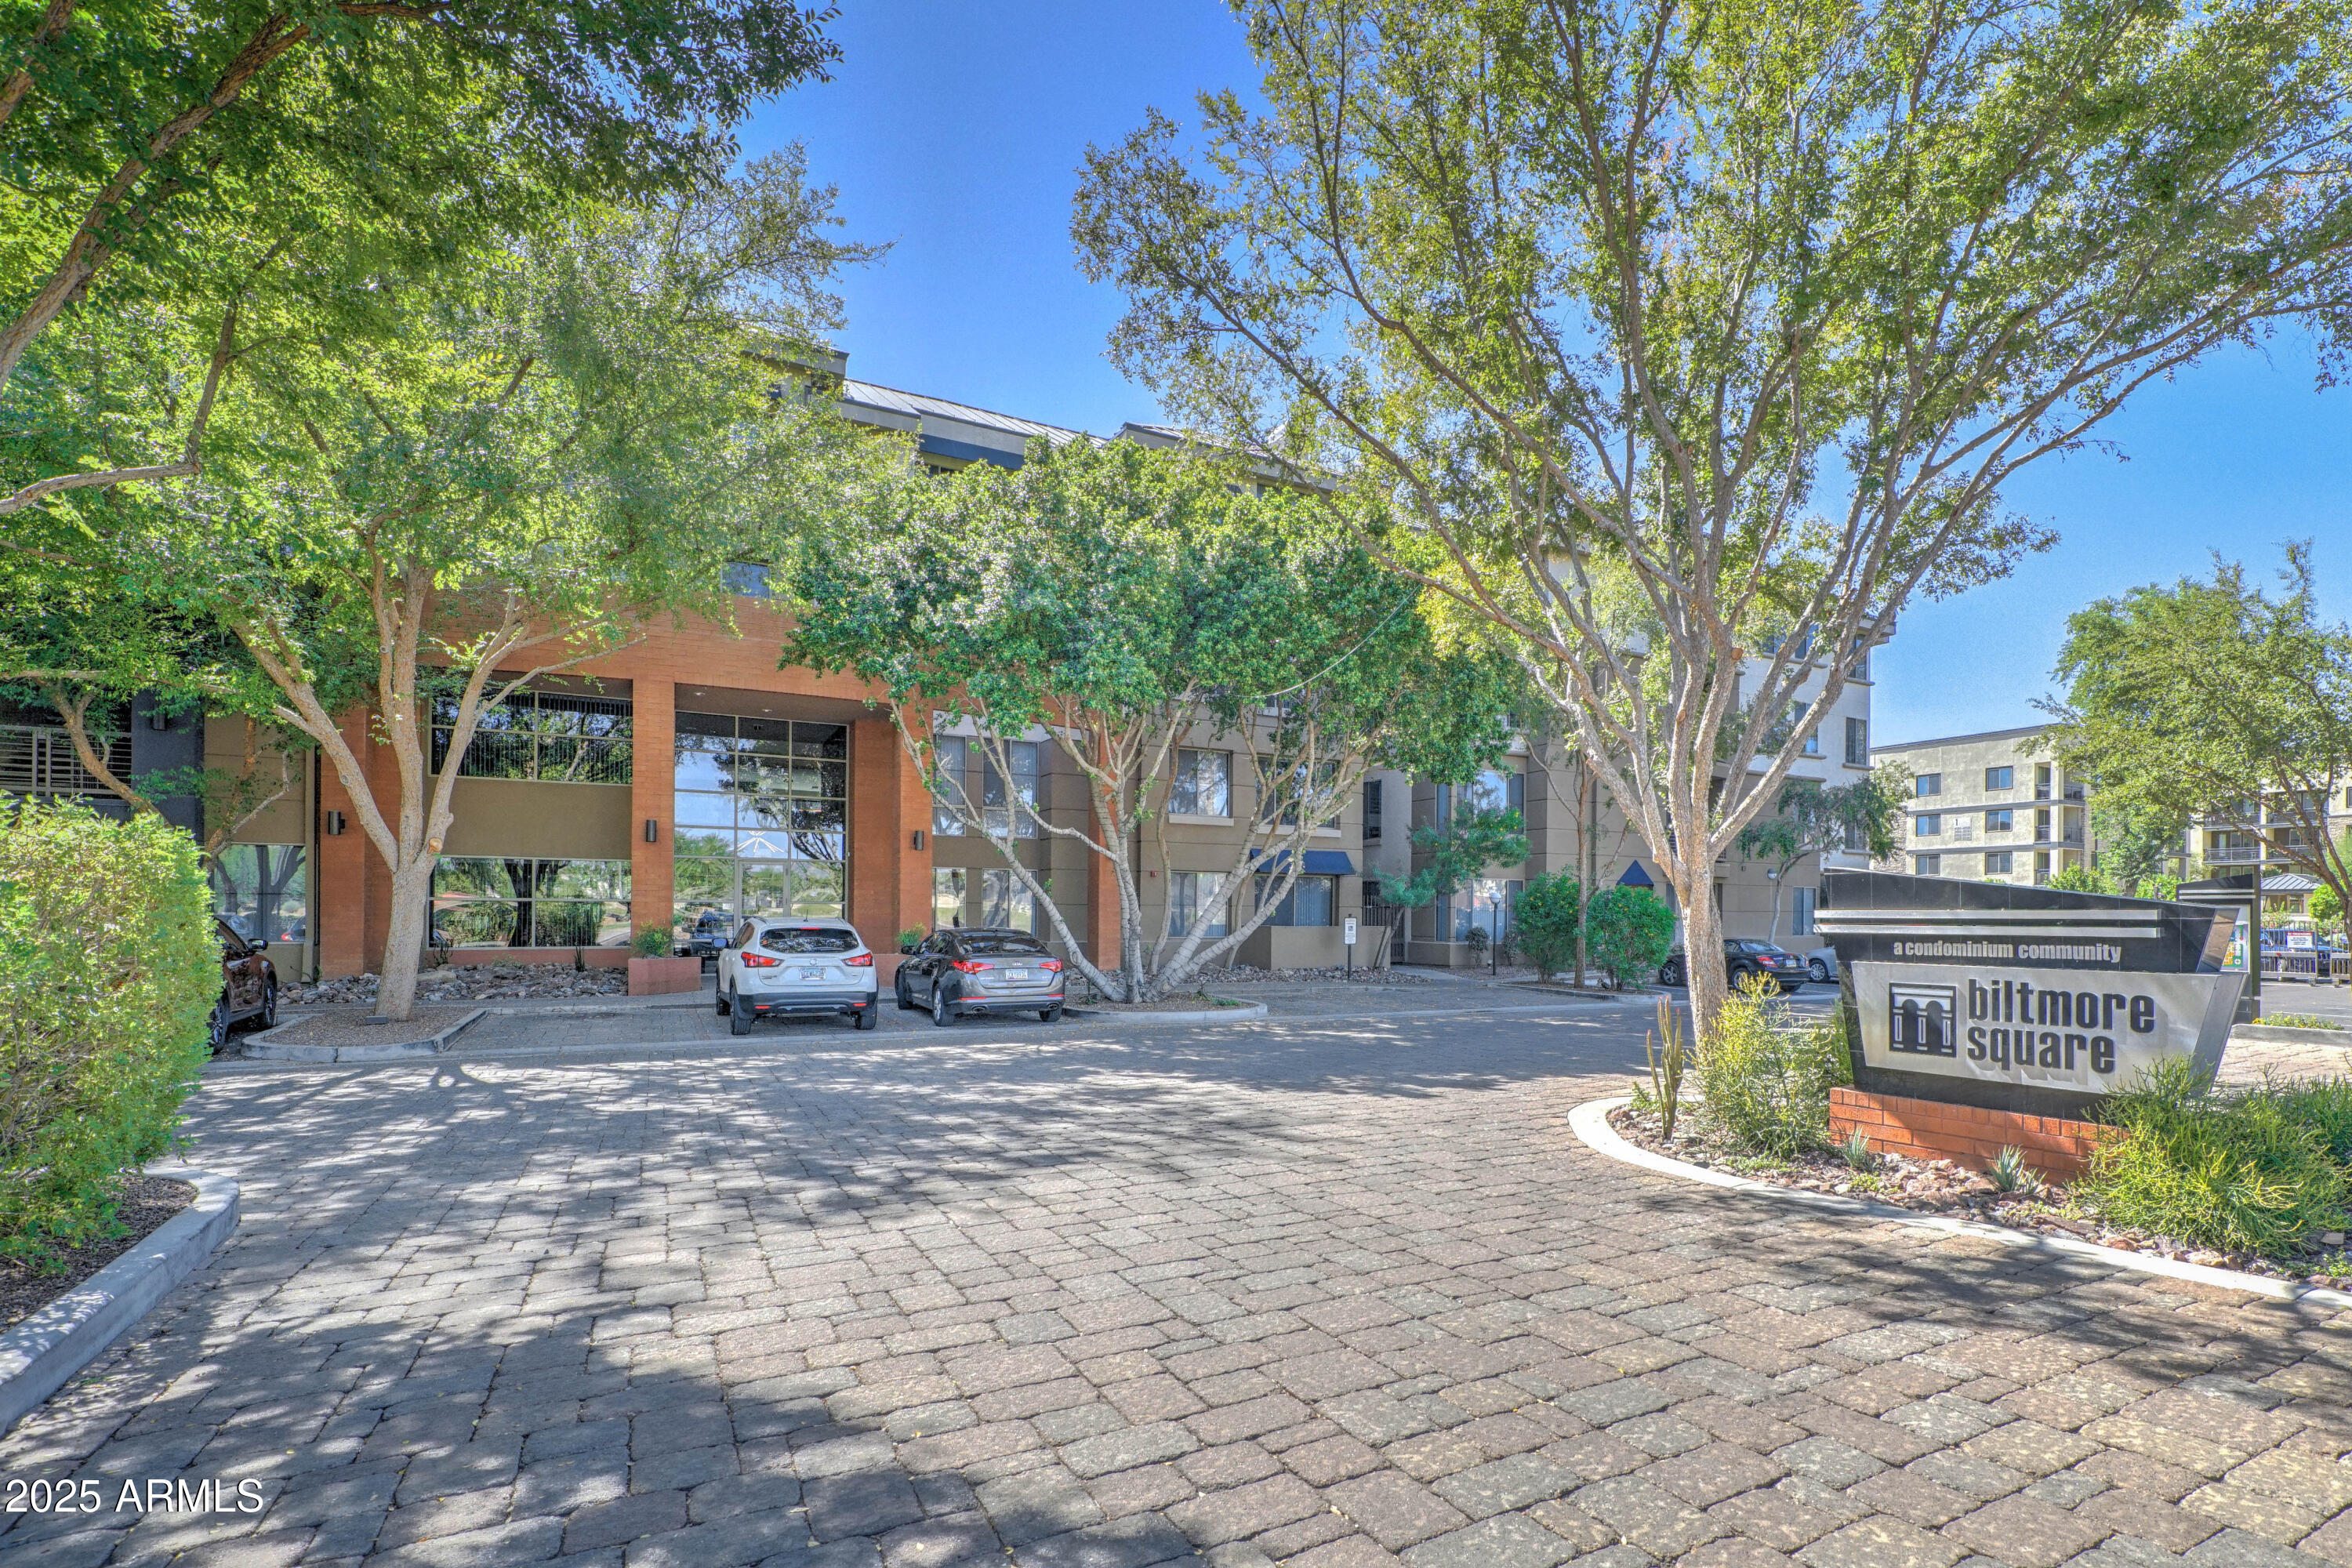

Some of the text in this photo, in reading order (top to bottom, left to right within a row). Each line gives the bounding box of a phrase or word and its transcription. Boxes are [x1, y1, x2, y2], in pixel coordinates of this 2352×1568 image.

[1893, 940, 2122, 963] a condominium community
[1968, 978, 2154, 1033] biltmore
[1967, 1025, 2115, 1073] square
